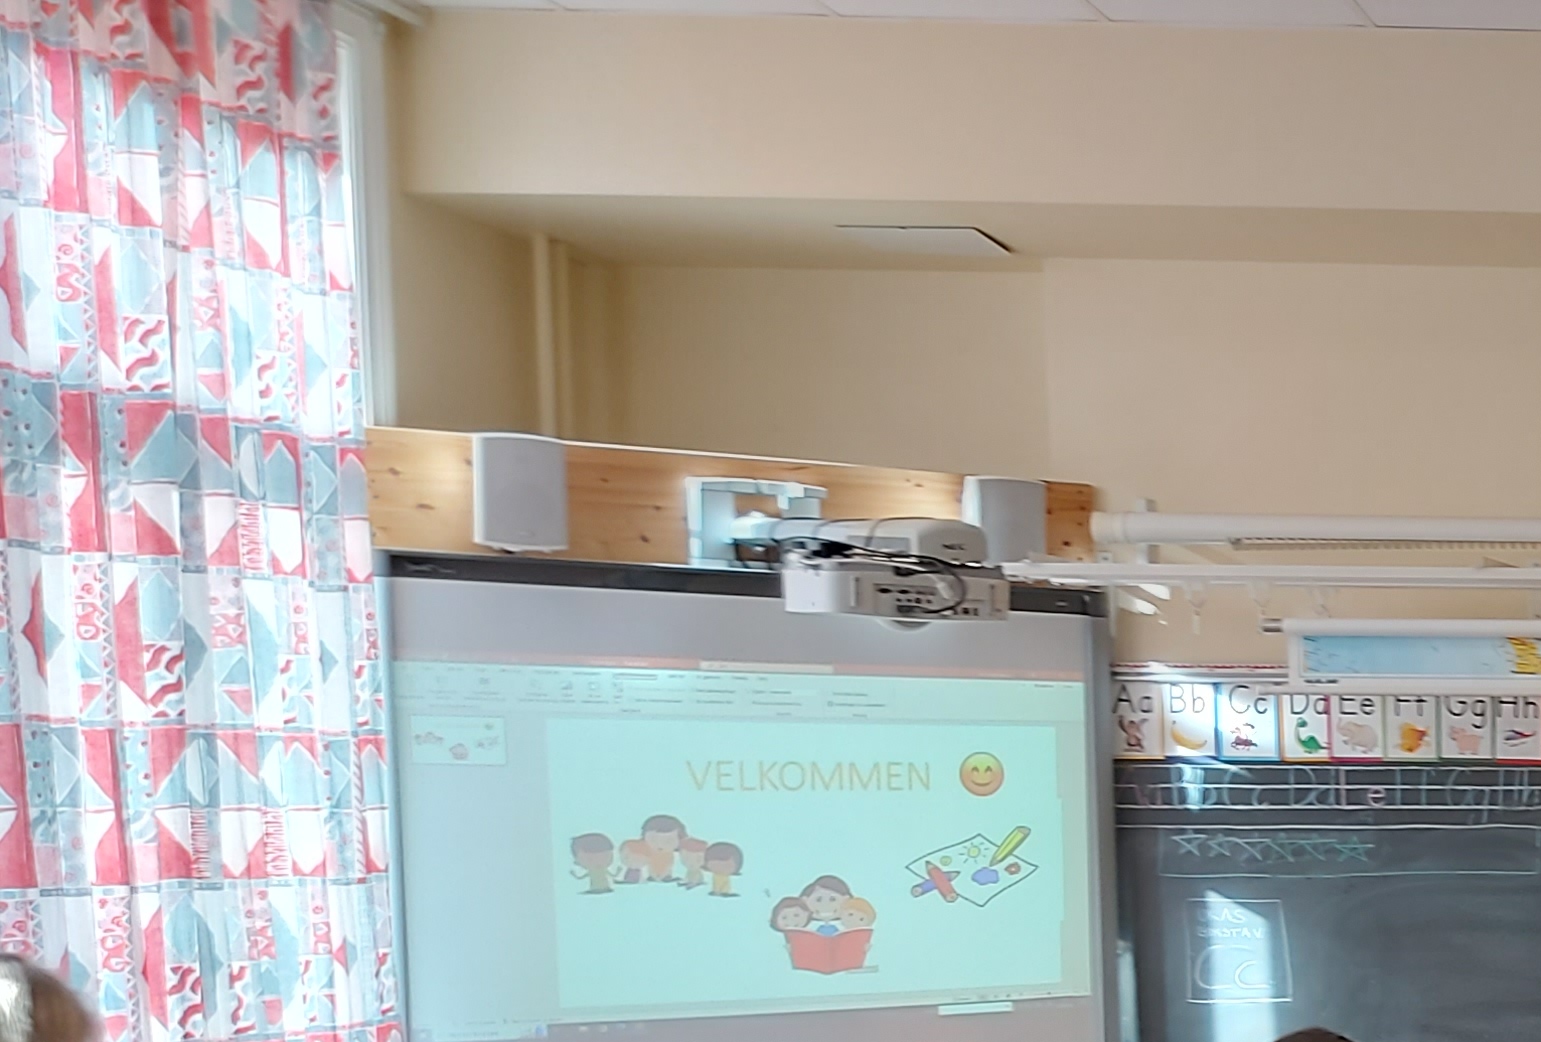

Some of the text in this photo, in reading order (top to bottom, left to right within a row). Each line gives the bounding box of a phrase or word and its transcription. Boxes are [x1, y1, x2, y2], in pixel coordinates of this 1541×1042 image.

[1112, 683, 1153, 714] Aa
[1169, 683, 1206, 714] Bb
[1229, 684, 1270, 714] Cc
[1339, 697, 1378, 715] Ee
[1446, 697, 1489, 729] Gg
[1497, 697, 1541, 719] Hh
[686, 760, 931, 791] VELKOMMEN
